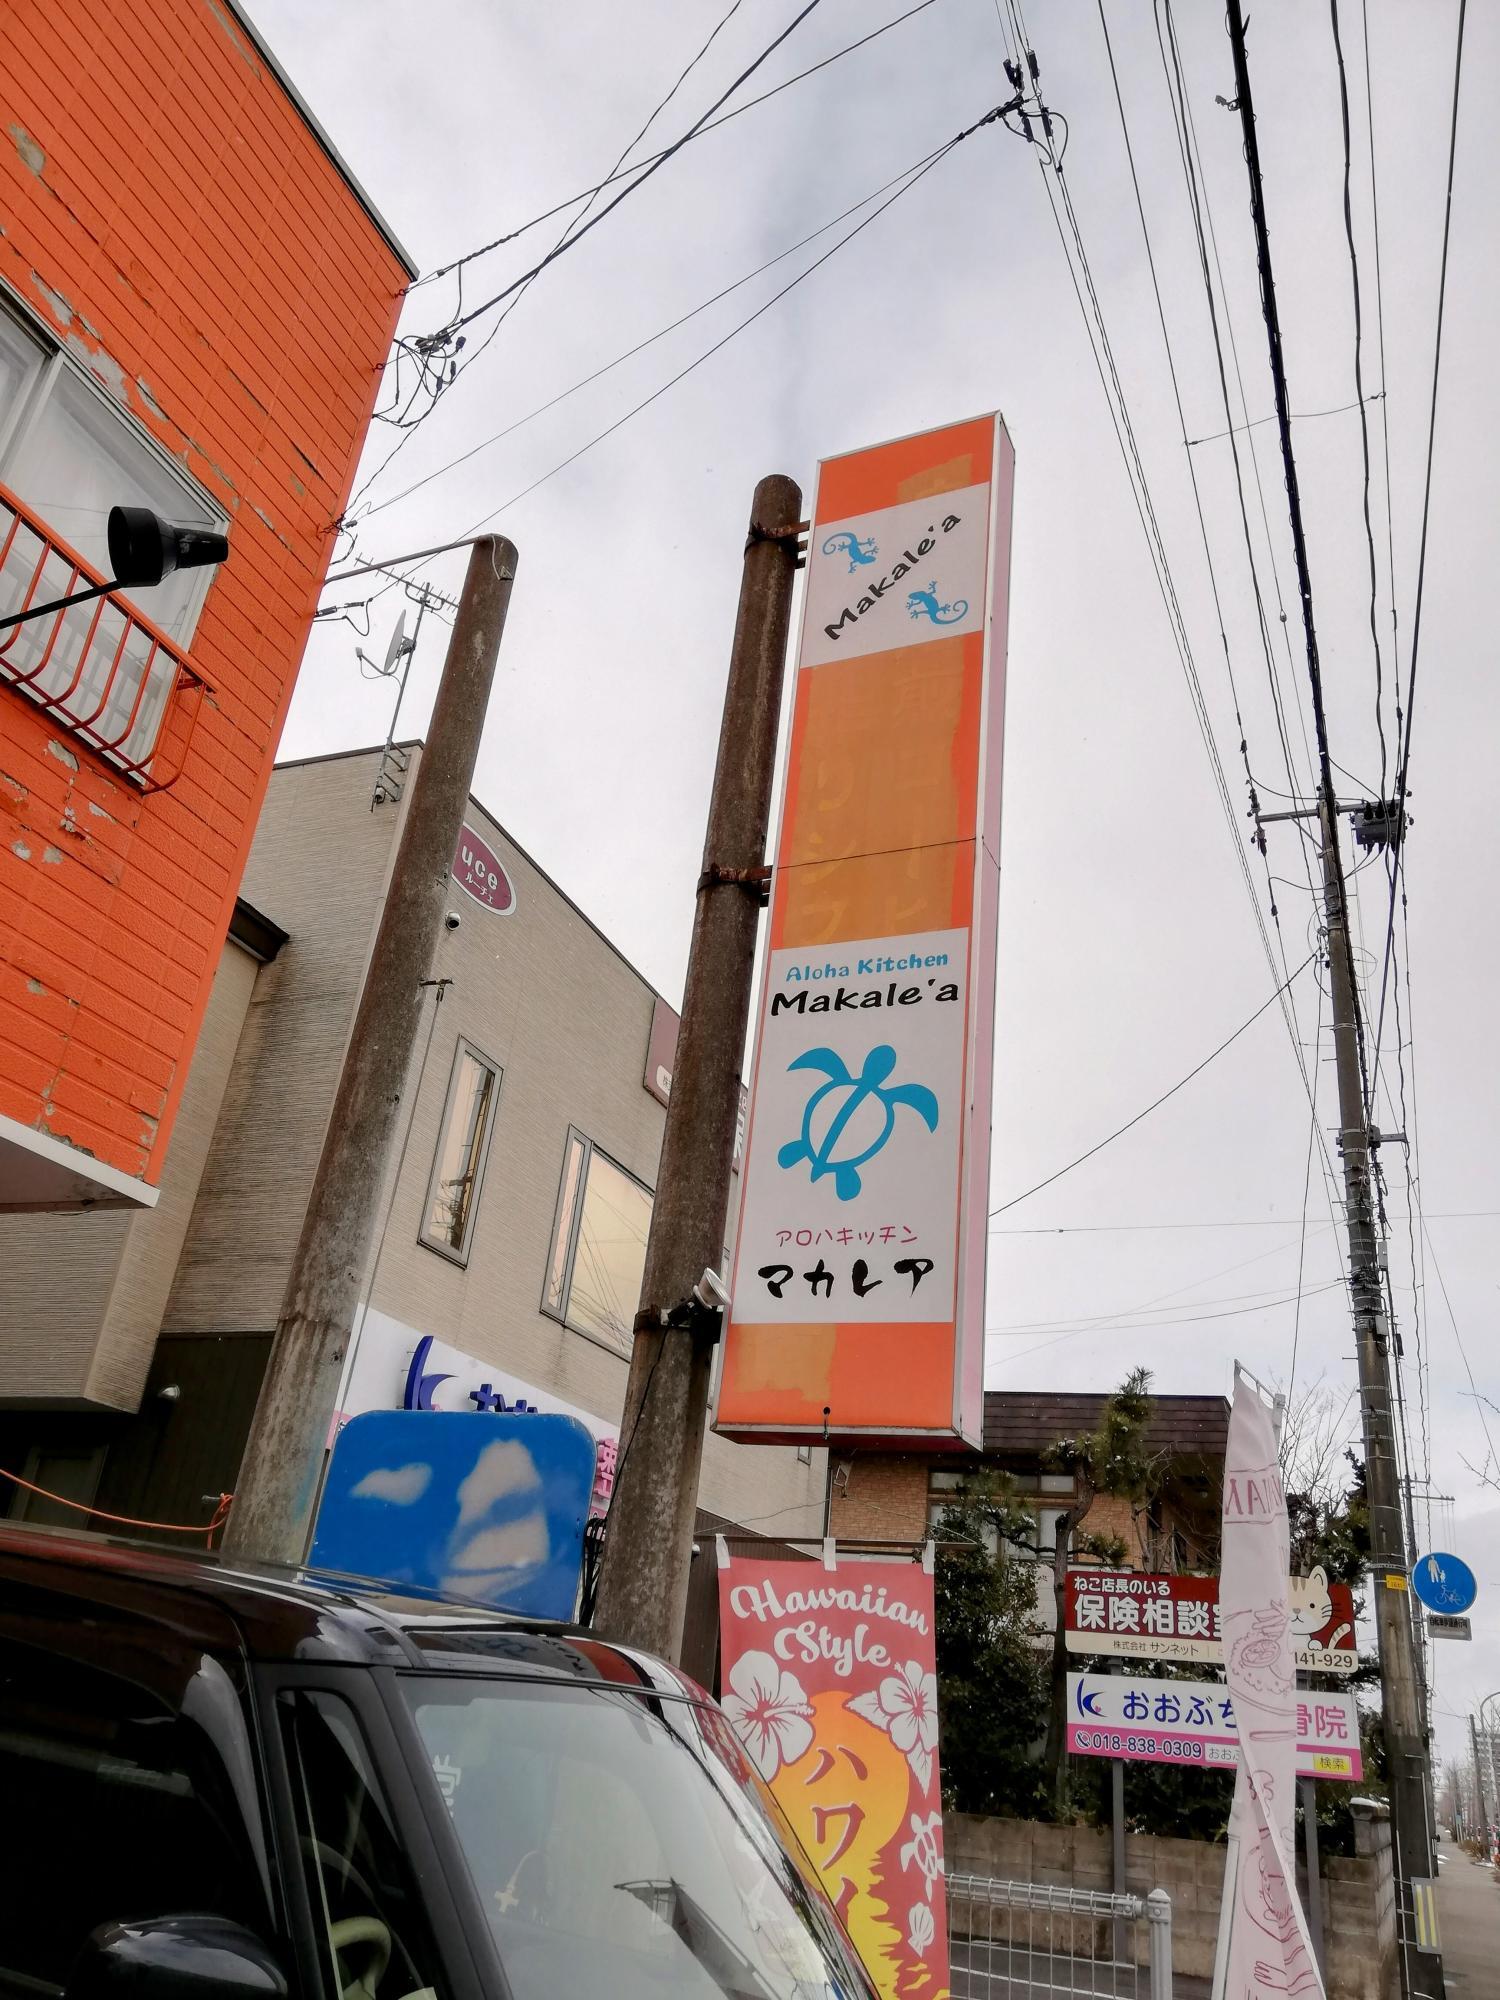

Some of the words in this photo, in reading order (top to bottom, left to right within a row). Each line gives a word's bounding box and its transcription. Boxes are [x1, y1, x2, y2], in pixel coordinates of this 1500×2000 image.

[824, 514, 962, 641] Makale'a
[465, 871, 494, 905] ルーチェ
[786, 964, 850, 982] Aloha
[857, 953, 949, 975] Kitchen
[771, 978, 959, 1016] Makale'a
[776, 1225, 918, 1247] アロハキッチン
[757, 1258, 935, 1299] マカレア
[1074, 1576, 1171, 1596] ねこ店長のいる
[729, 1578, 929, 1637] Hawaiian
[774, 1620, 892, 1677] Style
[1113, 1640, 1146, 1652] 株式会社
[1150, 1641, 1200, 1656] サンネット
[1093, 1733, 1202, 1758] 018-838-0309
[1319, 1757, 1346, 1770] 検索
